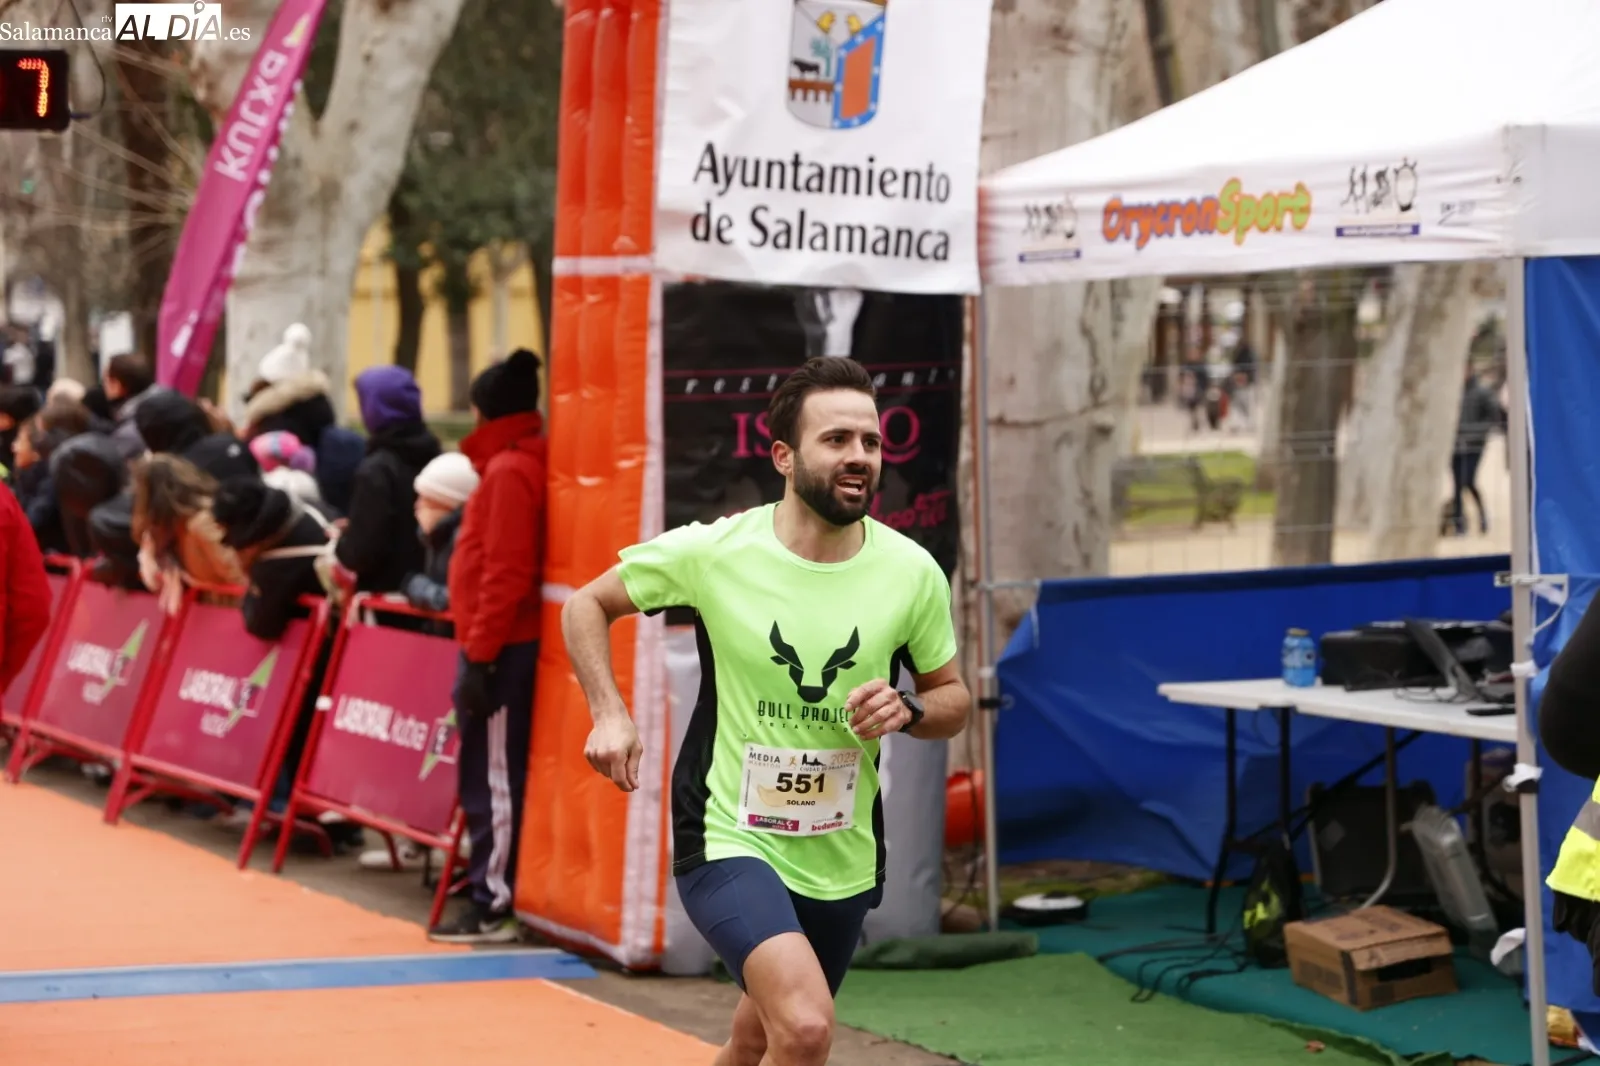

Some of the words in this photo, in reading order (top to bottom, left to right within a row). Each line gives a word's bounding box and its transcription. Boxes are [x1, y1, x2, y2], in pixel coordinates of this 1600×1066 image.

[692, 141, 950, 204] Ayuntamiento
[690, 201, 735, 245] de
[748, 204, 950, 262] Salamanca
[758, 701, 792, 719] BULL
[801, 706, 855, 723] PROJEC
[749, 752, 780, 763] MEDIA
[776, 773, 825, 793] 551
[754, 816, 785, 826] LABORAL
